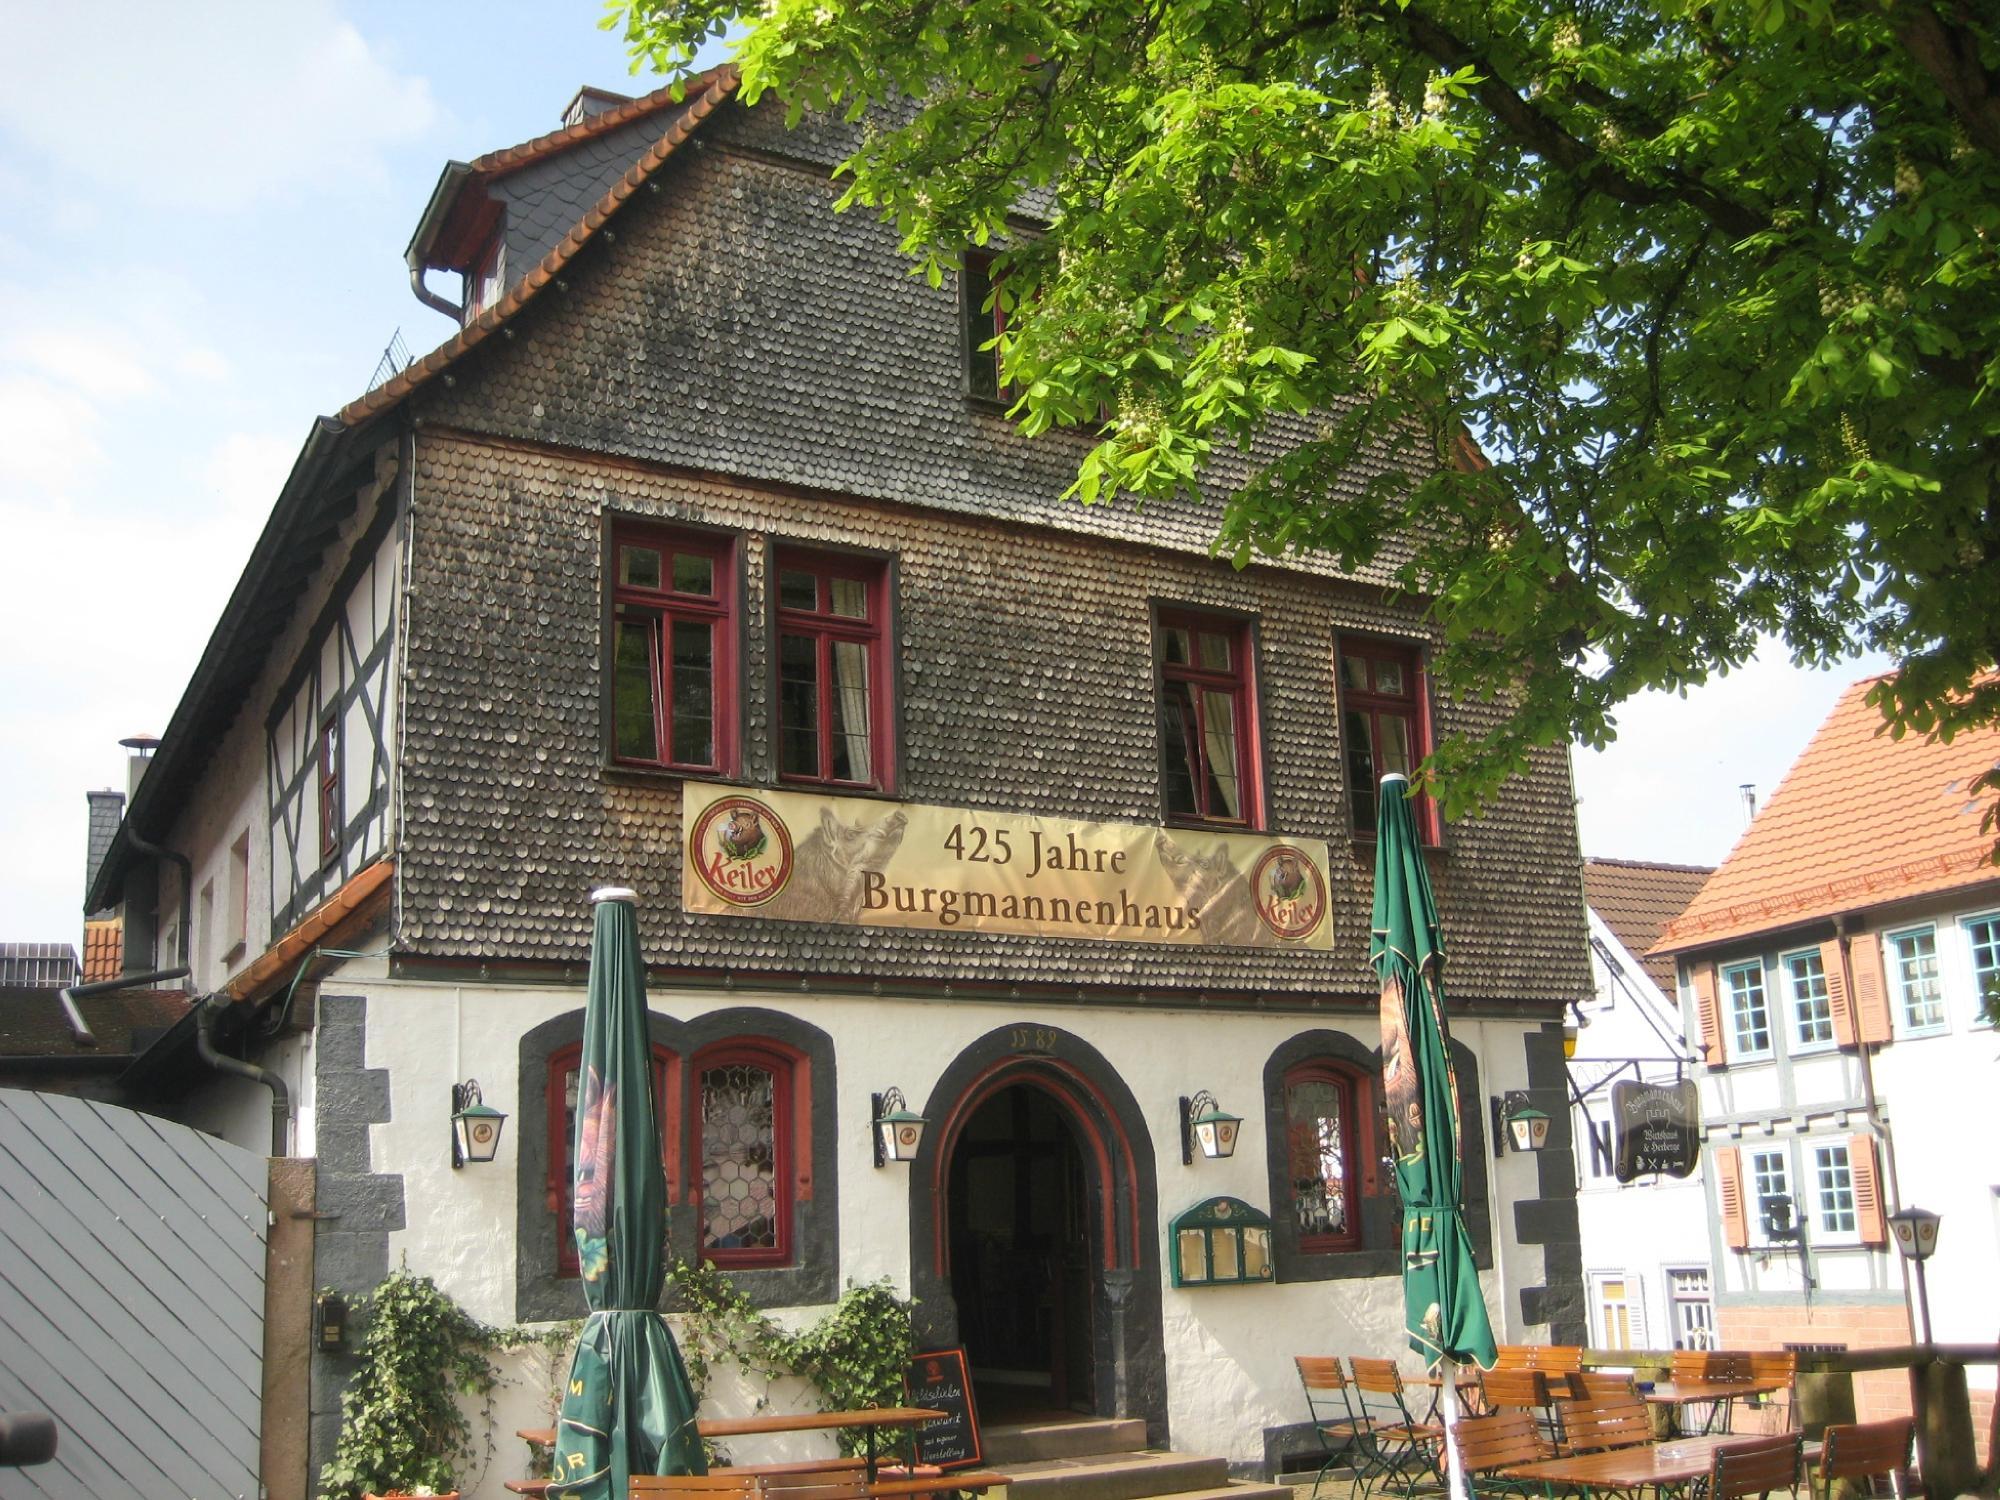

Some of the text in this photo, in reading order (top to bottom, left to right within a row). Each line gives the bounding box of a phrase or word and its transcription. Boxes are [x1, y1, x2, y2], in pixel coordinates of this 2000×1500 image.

[708, 852, 777, 890] Keiler
[944, 824, 1127, 878] 425 Jahre
[862, 871, 1201, 931] Burgmannenhaus
[1264, 894, 1314, 925] Keiler
